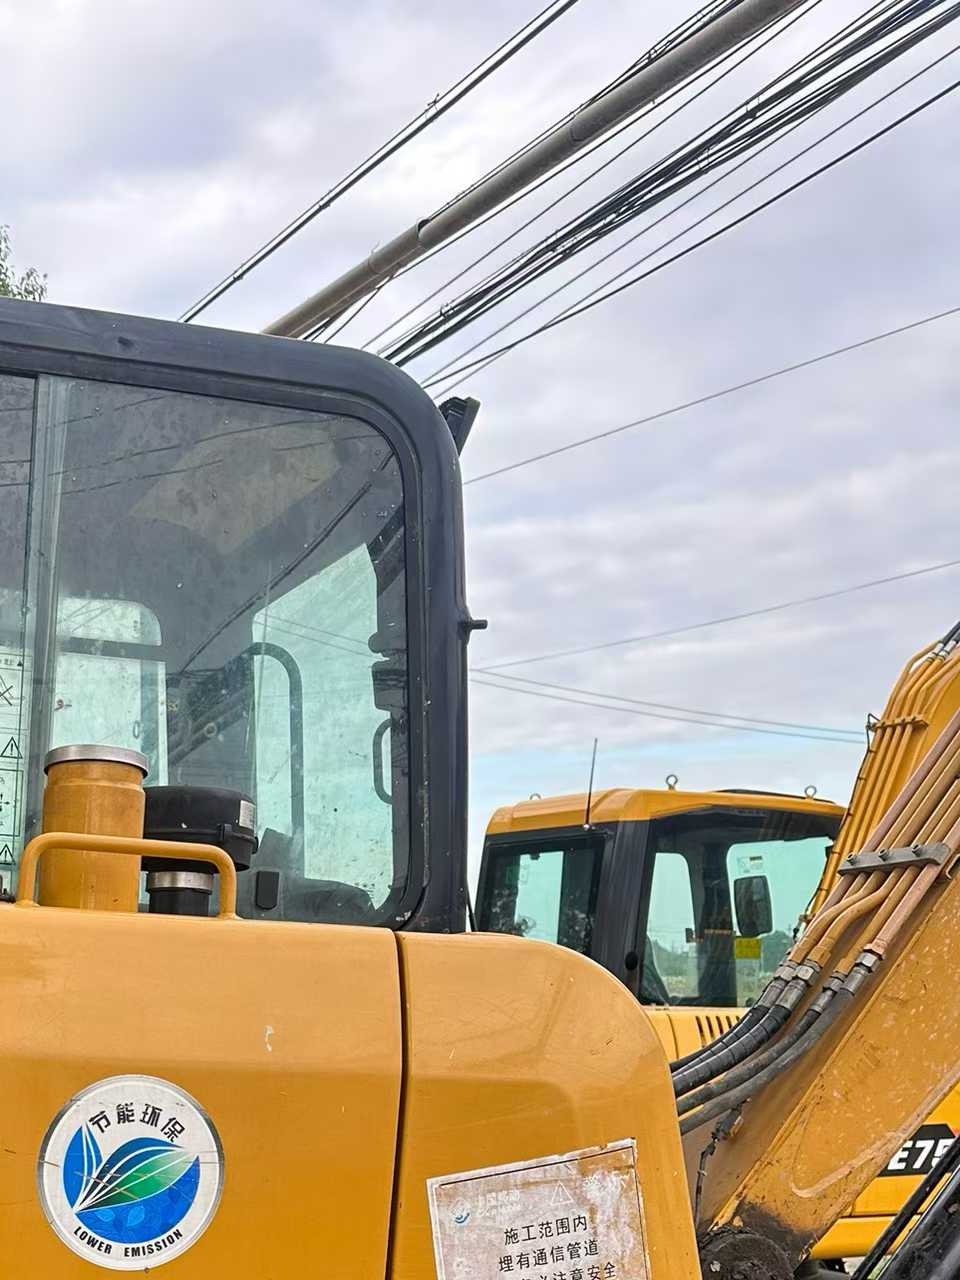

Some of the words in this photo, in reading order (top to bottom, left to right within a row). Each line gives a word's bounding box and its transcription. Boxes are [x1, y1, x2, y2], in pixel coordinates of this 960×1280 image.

[89, 1102, 186, 1143] 节能环保
[73, 1225, 114, 1255] LOWER
[124, 1228, 183, 1258] EMISSION
[504, 1214, 588, 1246] 施工范围内
[498, 1239, 599, 1273] 埋有通信管道
